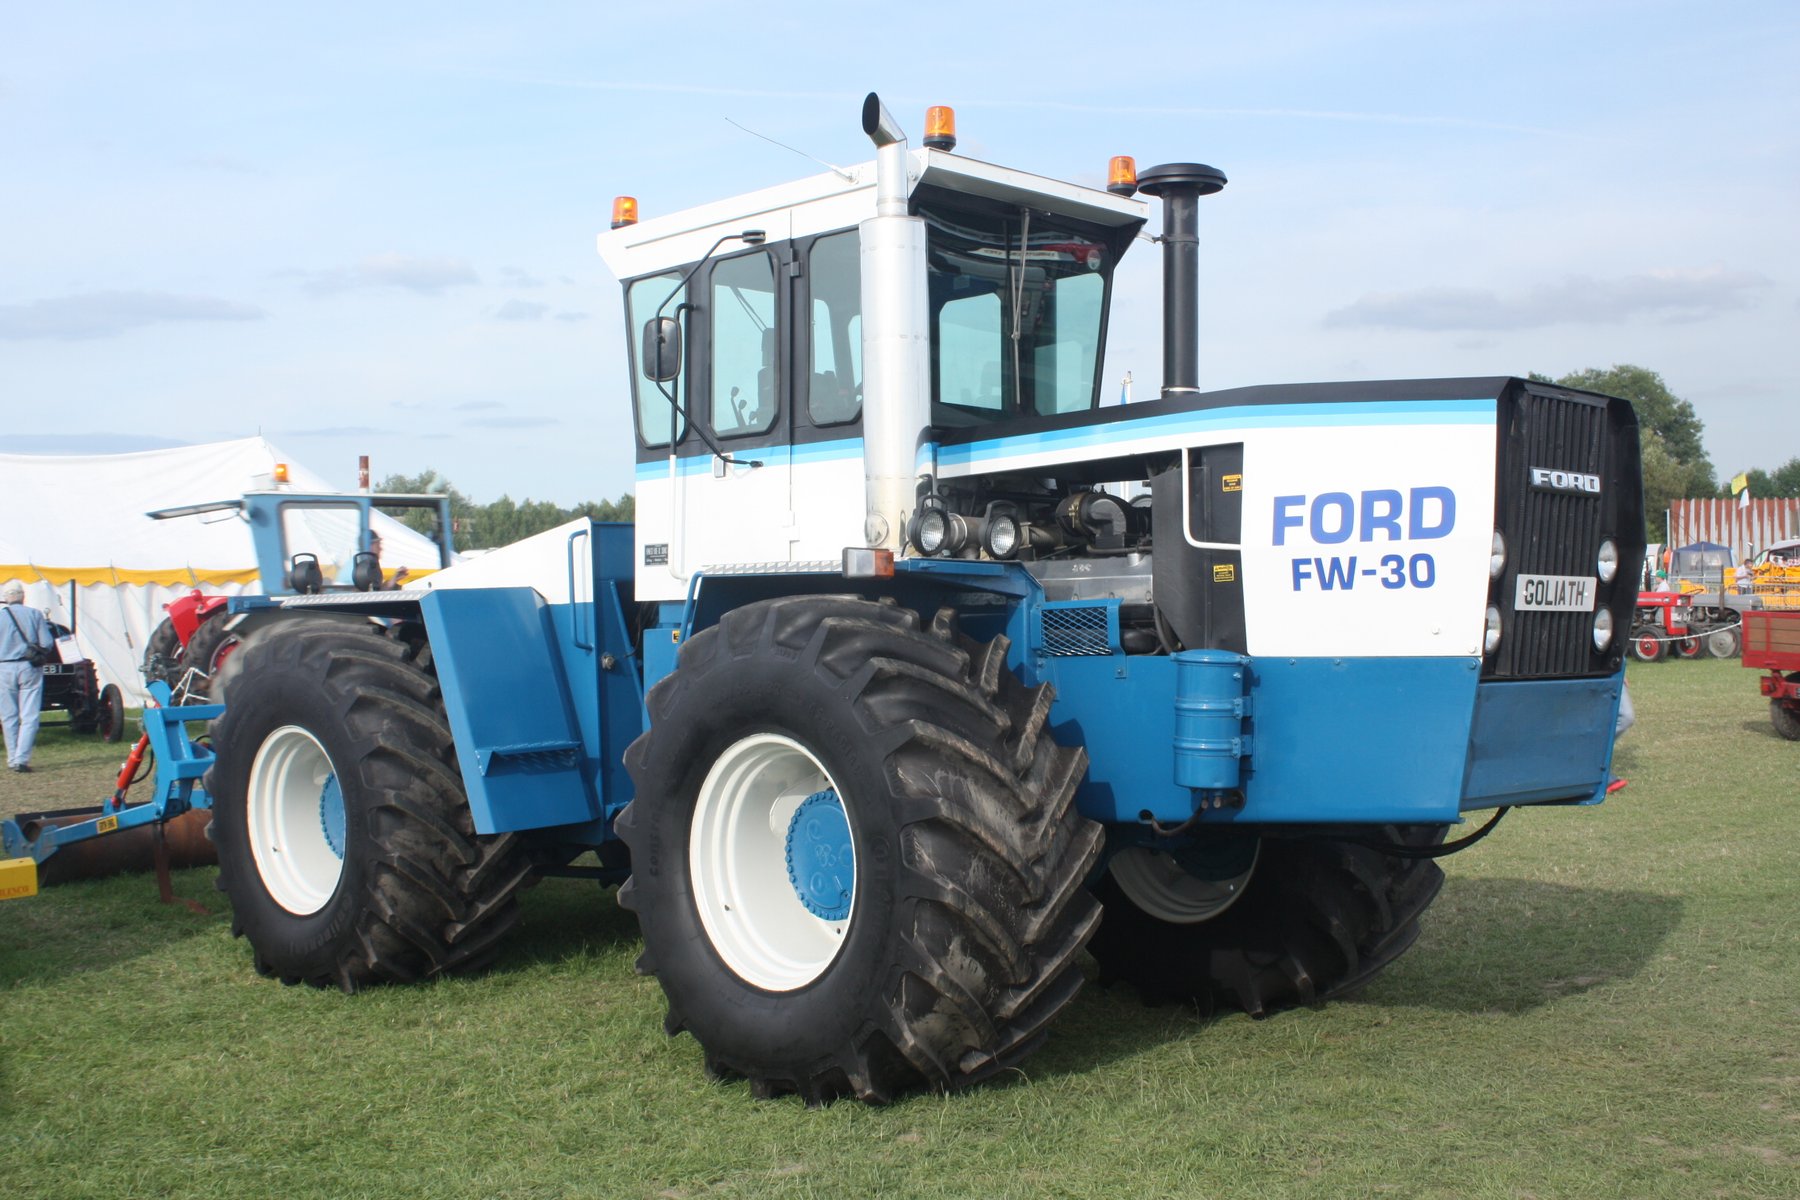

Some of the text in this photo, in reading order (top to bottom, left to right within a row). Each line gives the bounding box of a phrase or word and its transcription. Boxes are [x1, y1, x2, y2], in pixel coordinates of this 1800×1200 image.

[1533, 468, 1601, 493] FORD
[1271, 485, 1457, 546] FORD
[1291, 552, 1436, 592] FW-30
[1523, 578, 1586, 607] GOLIATH
